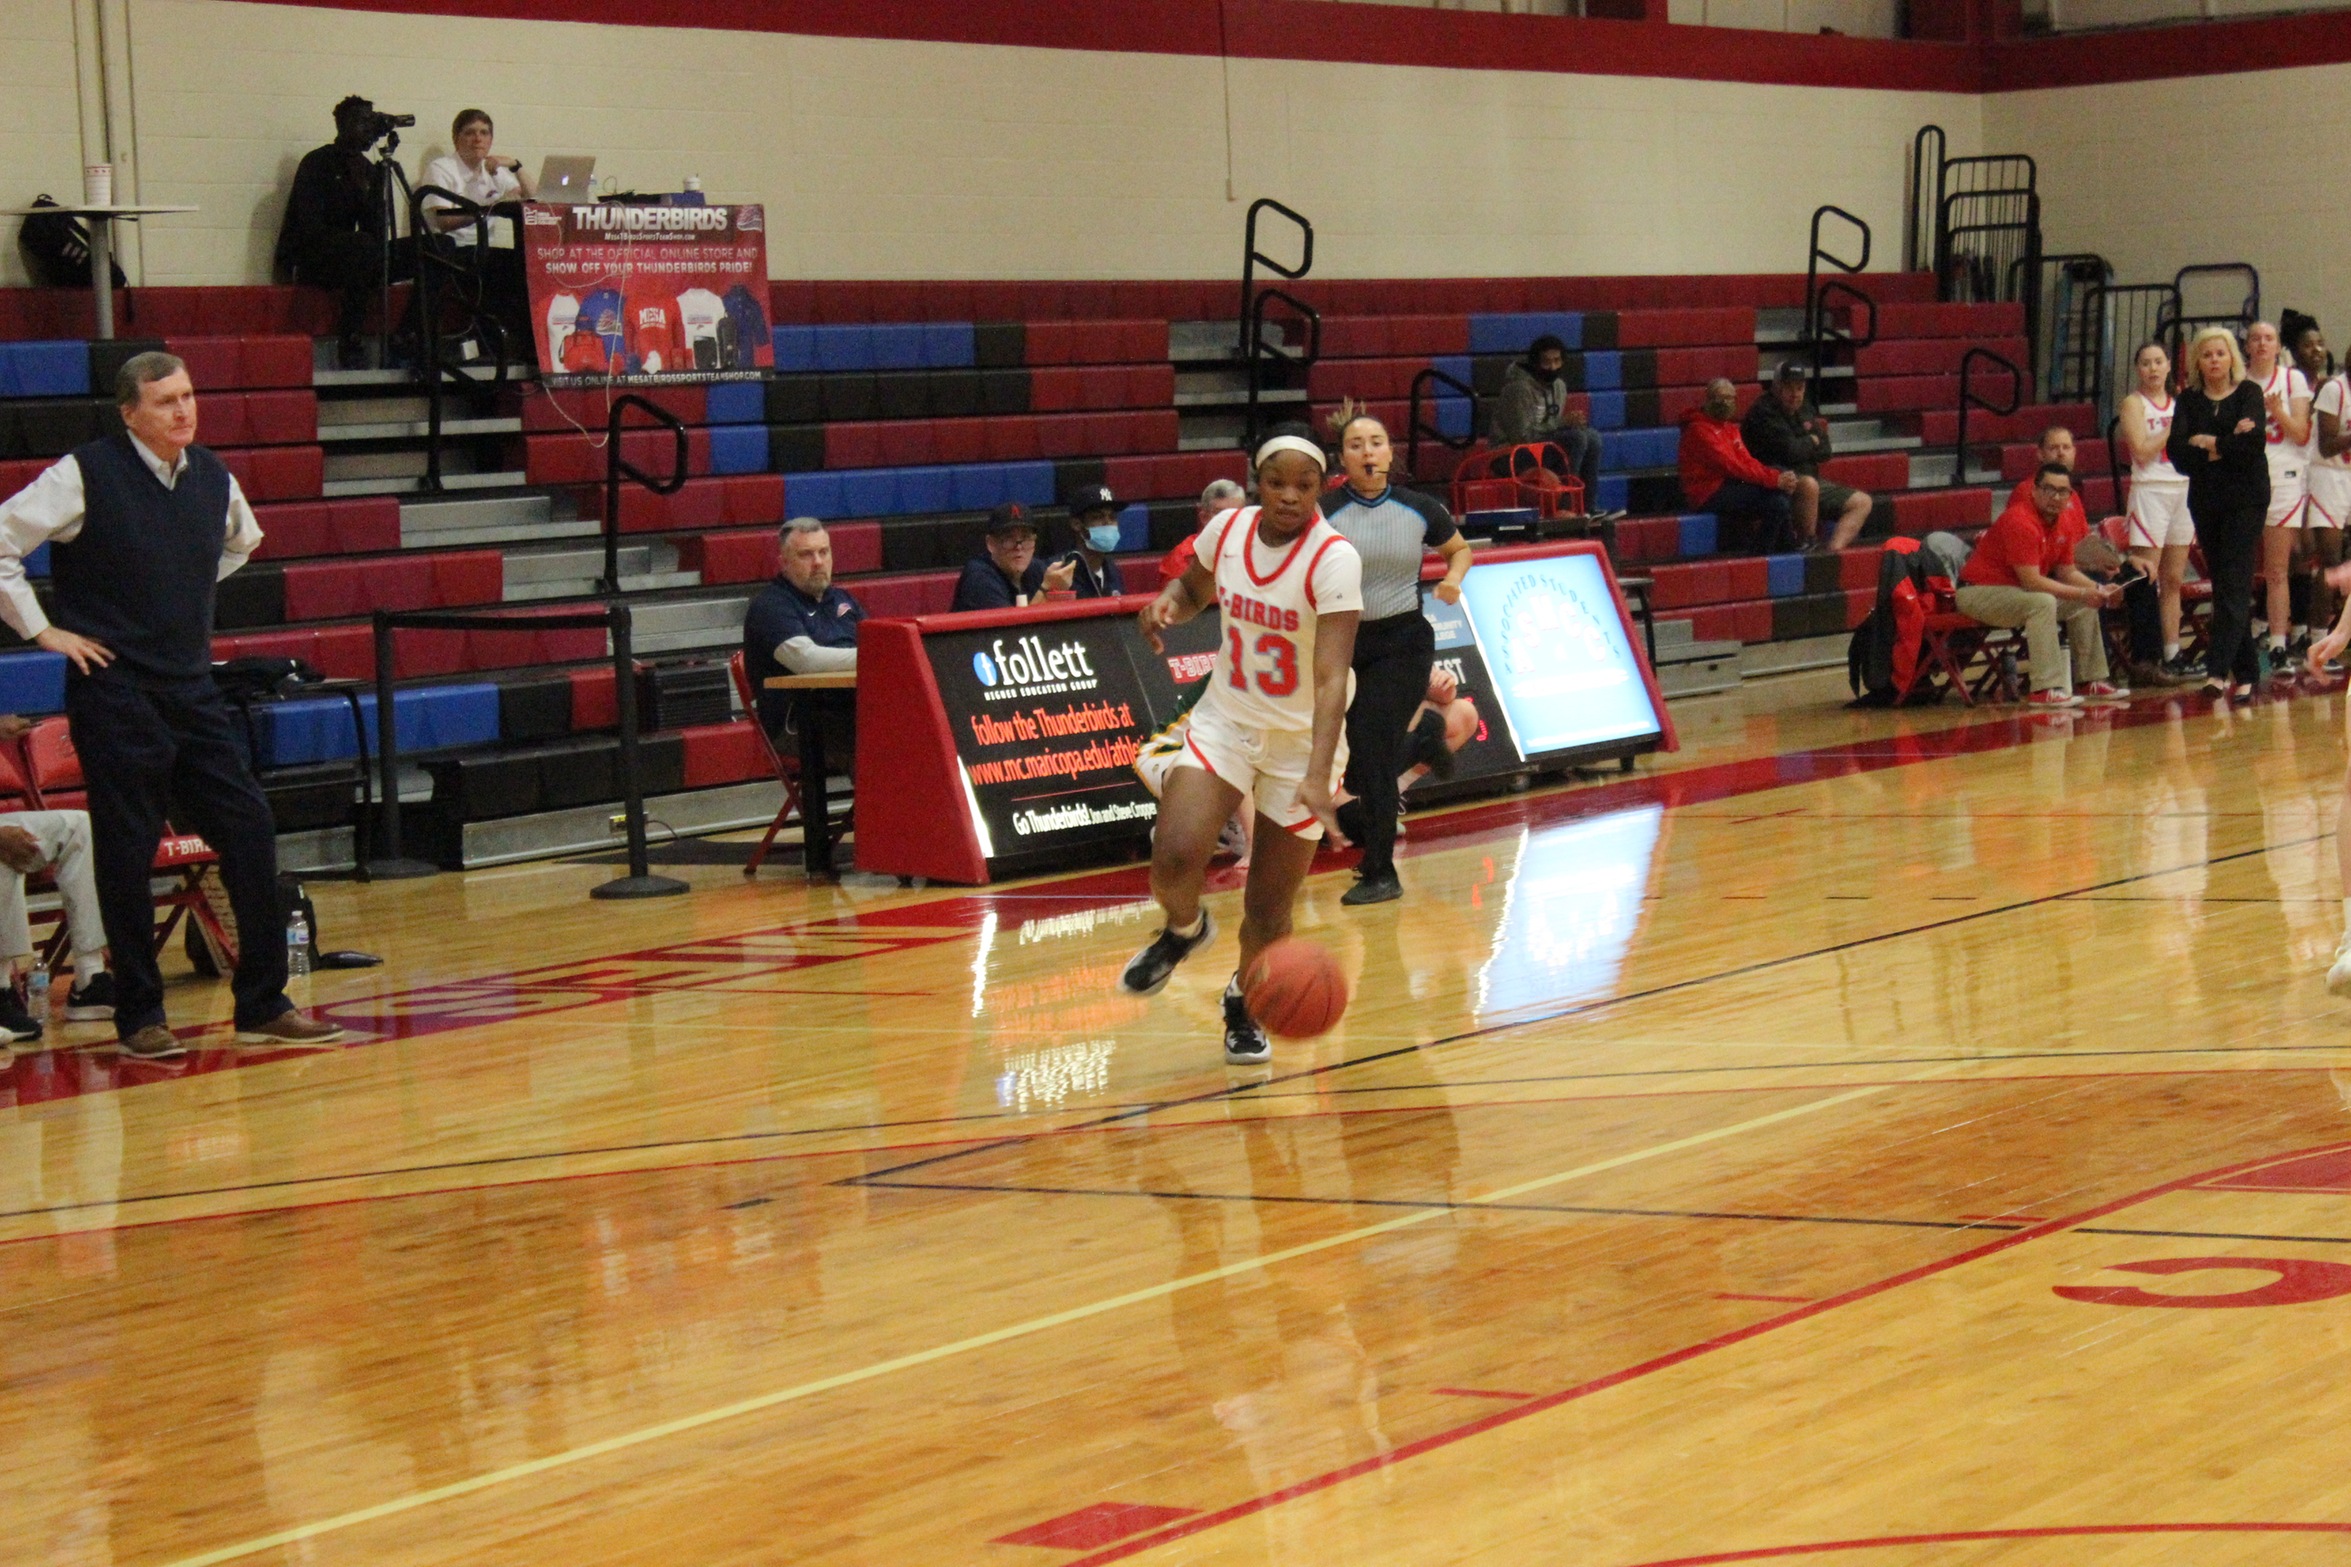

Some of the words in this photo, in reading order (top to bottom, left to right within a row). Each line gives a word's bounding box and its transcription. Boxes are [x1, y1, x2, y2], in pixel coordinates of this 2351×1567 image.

[572, 206, 728, 231] THUNDERBIRDS
[537, 248, 565, 260] SHOP
[569, 248, 583, 260] AT
[586, 248, 604, 260] THE
[607, 248, 657, 260] OFFICIAL
[660, 248, 700, 260] ONLINE
[703, 247, 733, 260] STORE
[736, 247, 758, 260] AND
[545, 262, 577, 274] SHOW
[581, 262, 600, 274] OFF
[603, 262, 634, 274] YOUR
[637, 262, 717, 274] THUNDERBIRDS
[719, 261, 753, 273] PRIDE!
[639, 307, 666, 325] MESA
[585, 375, 613, 385] ONLINE
[616, 375, 626, 385] AT
[993, 635, 1095, 686] follett
[1227, 624, 1299, 697] 13
[983, 689, 1018, 701] HIGHER
[1020, 682, 1068, 698] EDUCATION
[1070, 679, 1098, 692] GROUP
[971, 714, 1016, 746] follow
[1013, 710, 1040, 741] the
[1033, 699, 1120, 738] Thunderbirds
[1117, 702, 1136, 728] at
[1012, 811, 1031, 836] Go
